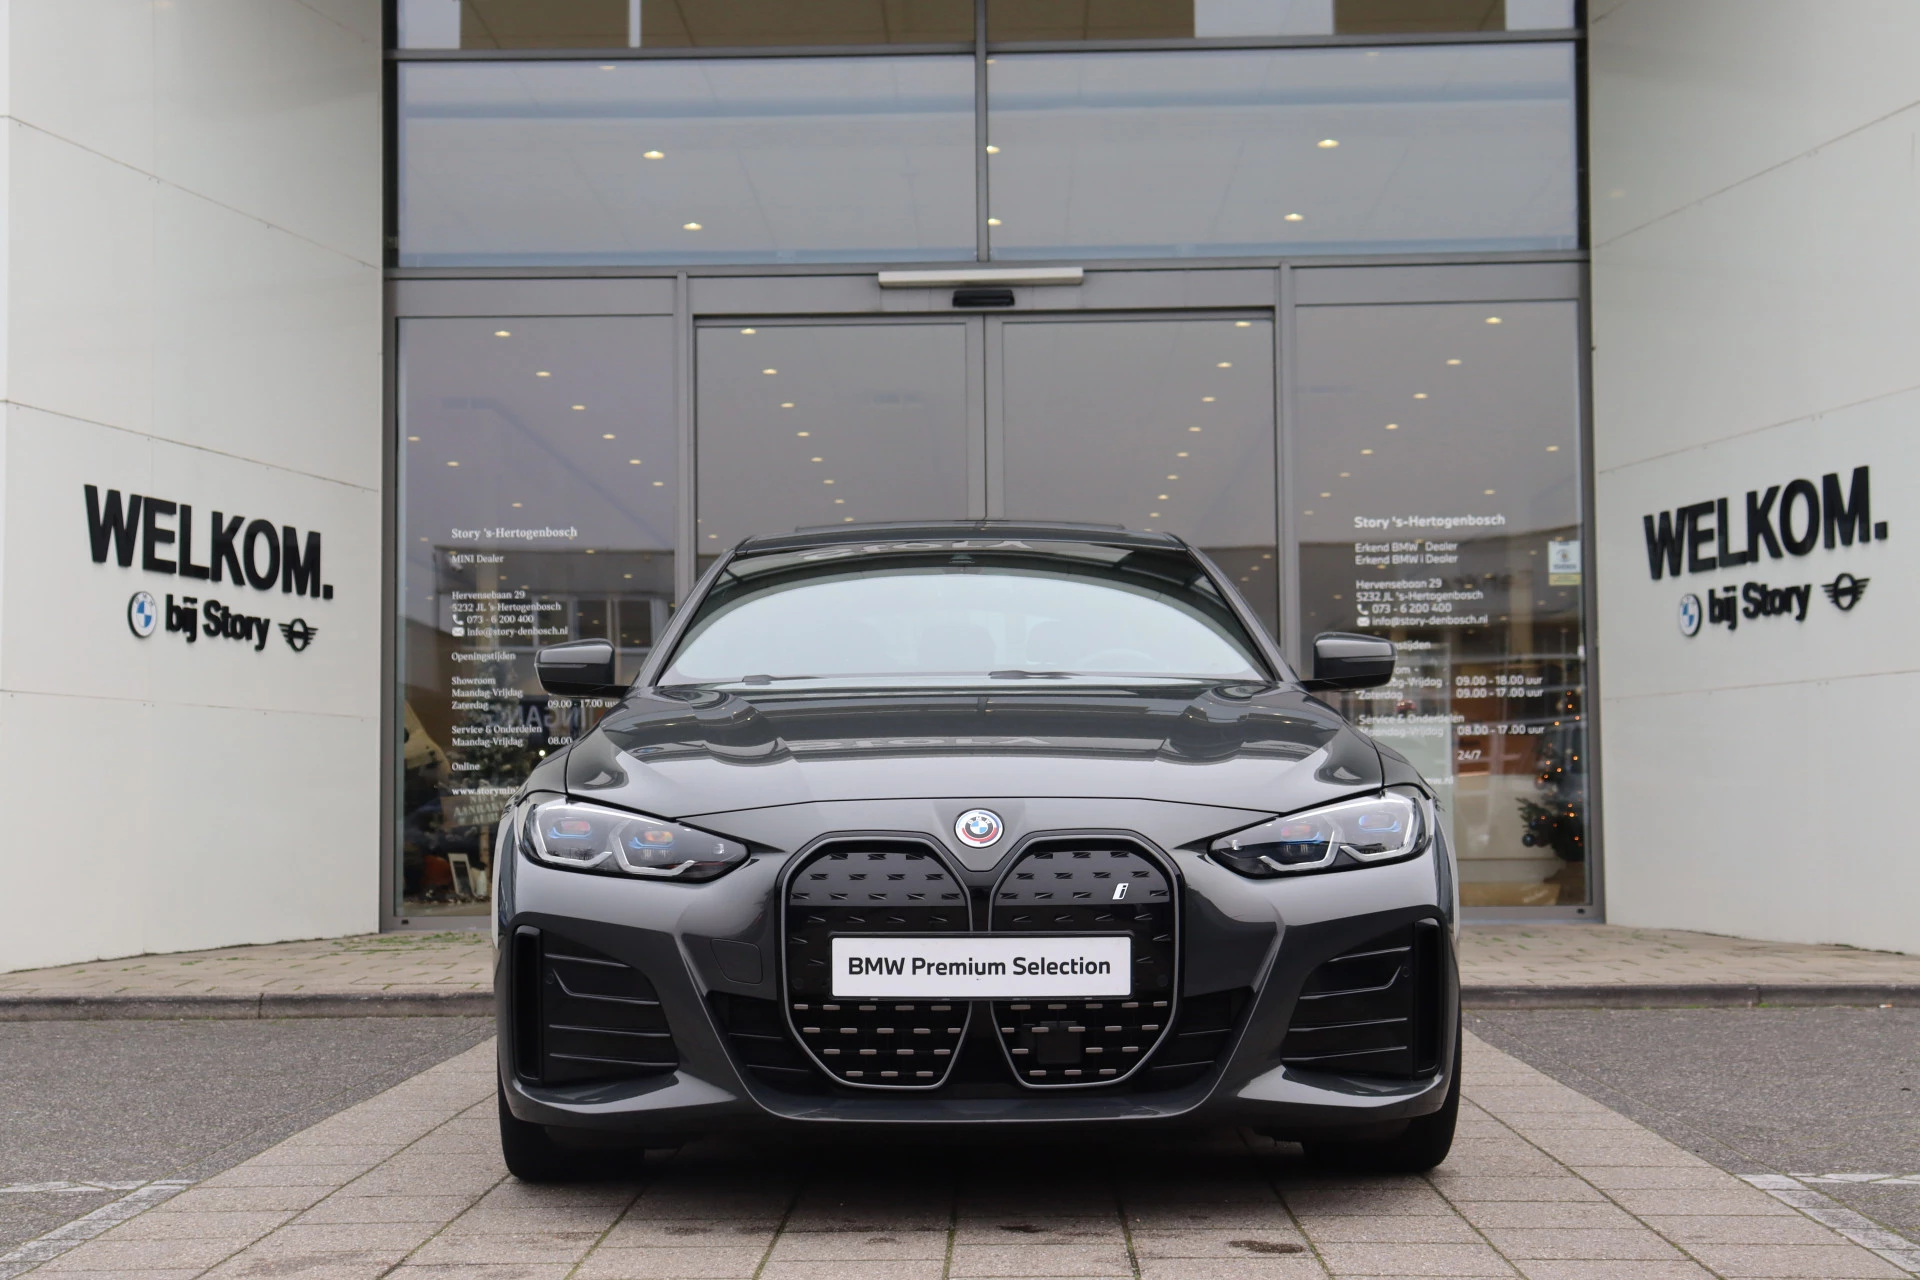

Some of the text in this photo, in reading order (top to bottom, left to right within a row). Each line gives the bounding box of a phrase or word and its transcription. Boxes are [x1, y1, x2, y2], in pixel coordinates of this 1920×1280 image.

[1354, 514, 1506, 530] Story 's-Hertogenbosch
[1643, 465, 1889, 581] WELKOM.
[451, 526, 578, 541] Story 's-Hertogenbosch
[84, 484, 334, 600] WELKOM.
[1355, 541, 1459, 553] Erkend BMW Dealer
[451, 554, 505, 564] MINI Dealer
[1355, 555, 1389, 565] Erkend
[1392, 555, 1418, 564] BMW
[1426, 554, 1459, 564] Dealer
[1356, 578, 1442, 590] Hervensebaan 29
[451, 590, 526, 600] Hervensebaan 29
[1356, 592, 1381, 602] 5232
[1382, 591, 1394, 602] JL
[451, 603, 473, 612] 5232
[475, 603, 486, 612] JL
[1372, 604, 1391, 614] 073
[1400, 604, 1407, 613] 6
[1409, 603, 1430, 613] 200
[1431, 603, 1452, 613] 400
[1708, 582, 1812, 631] bij Story
[165, 594, 270, 652] bij Story
[466, 615, 484, 624] 073
[491, 615, 497, 624] 6
[498, 615, 516, 624] 200
[517, 614, 534, 624] 400
[1372, 615, 1488, 628] info@story-denbosch.nl
[466, 626, 569, 638] info@story-denbosch.nl
[451, 651, 517, 663] Openingstijden
[451, 676, 496, 685] Showroom
[1456, 676, 1486, 686] 09.00
[1495, 675, 1524, 686] 18.00
[1526, 677, 1543, 685] uur
[451, 687, 524, 699] Maandag-Vrijdag
[1358, 689, 1403, 701] Zaterdag
[1456, 688, 1487, 699] 09.00
[1495, 687, 1525, 698] 17.00
[1527, 689, 1544, 697] uur
[451, 700, 489, 711] Zaterdag
[547, 700, 572, 709] 09.00
[580, 699, 603, 709] 17.00
[1359, 713, 1465, 726] Service & Onderdelen
[451, 724, 542, 734] Service & Onderdelen
[1457, 725, 1488, 736] 08.00
[1497, 725, 1526, 735] 17.00
[1527, 727, 1545, 735] uur
[451, 736, 572, 749] Maandag-Vrijdag 08.00
[1457, 750, 1482, 760] 24/7
[451, 761, 480, 771] Online
[848, 956, 1111, 976] BMW Premium Selection
